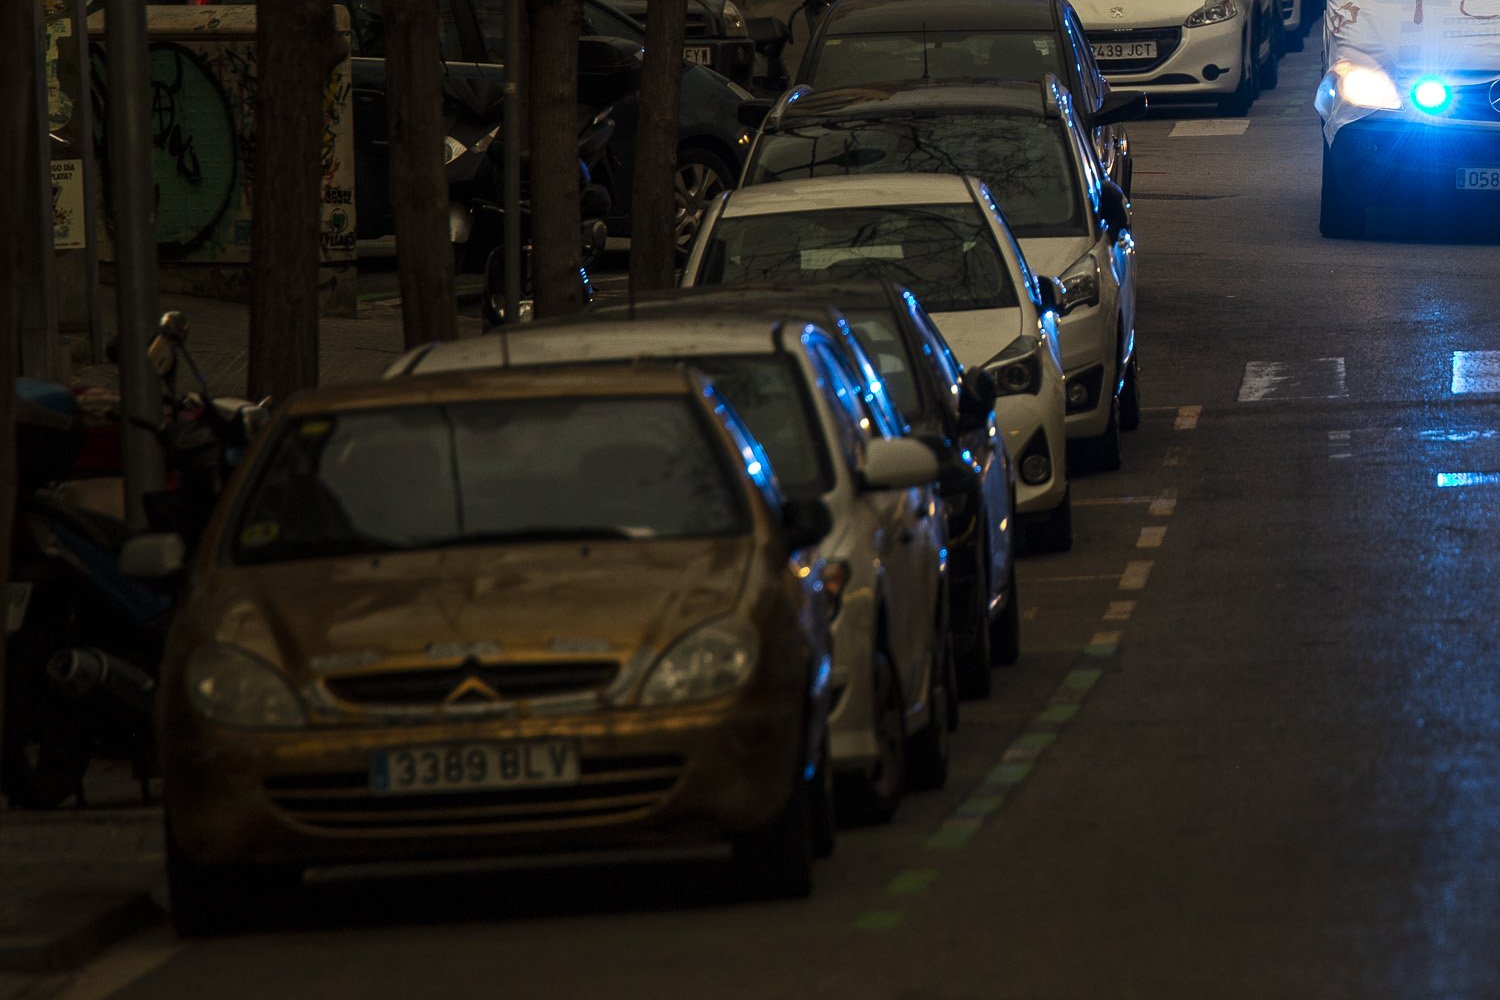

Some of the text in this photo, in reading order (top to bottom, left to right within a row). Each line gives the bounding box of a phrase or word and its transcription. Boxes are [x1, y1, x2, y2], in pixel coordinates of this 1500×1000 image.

[1127, 43, 1152, 57] JCT
[398, 746, 569, 786] 3389 BLV
